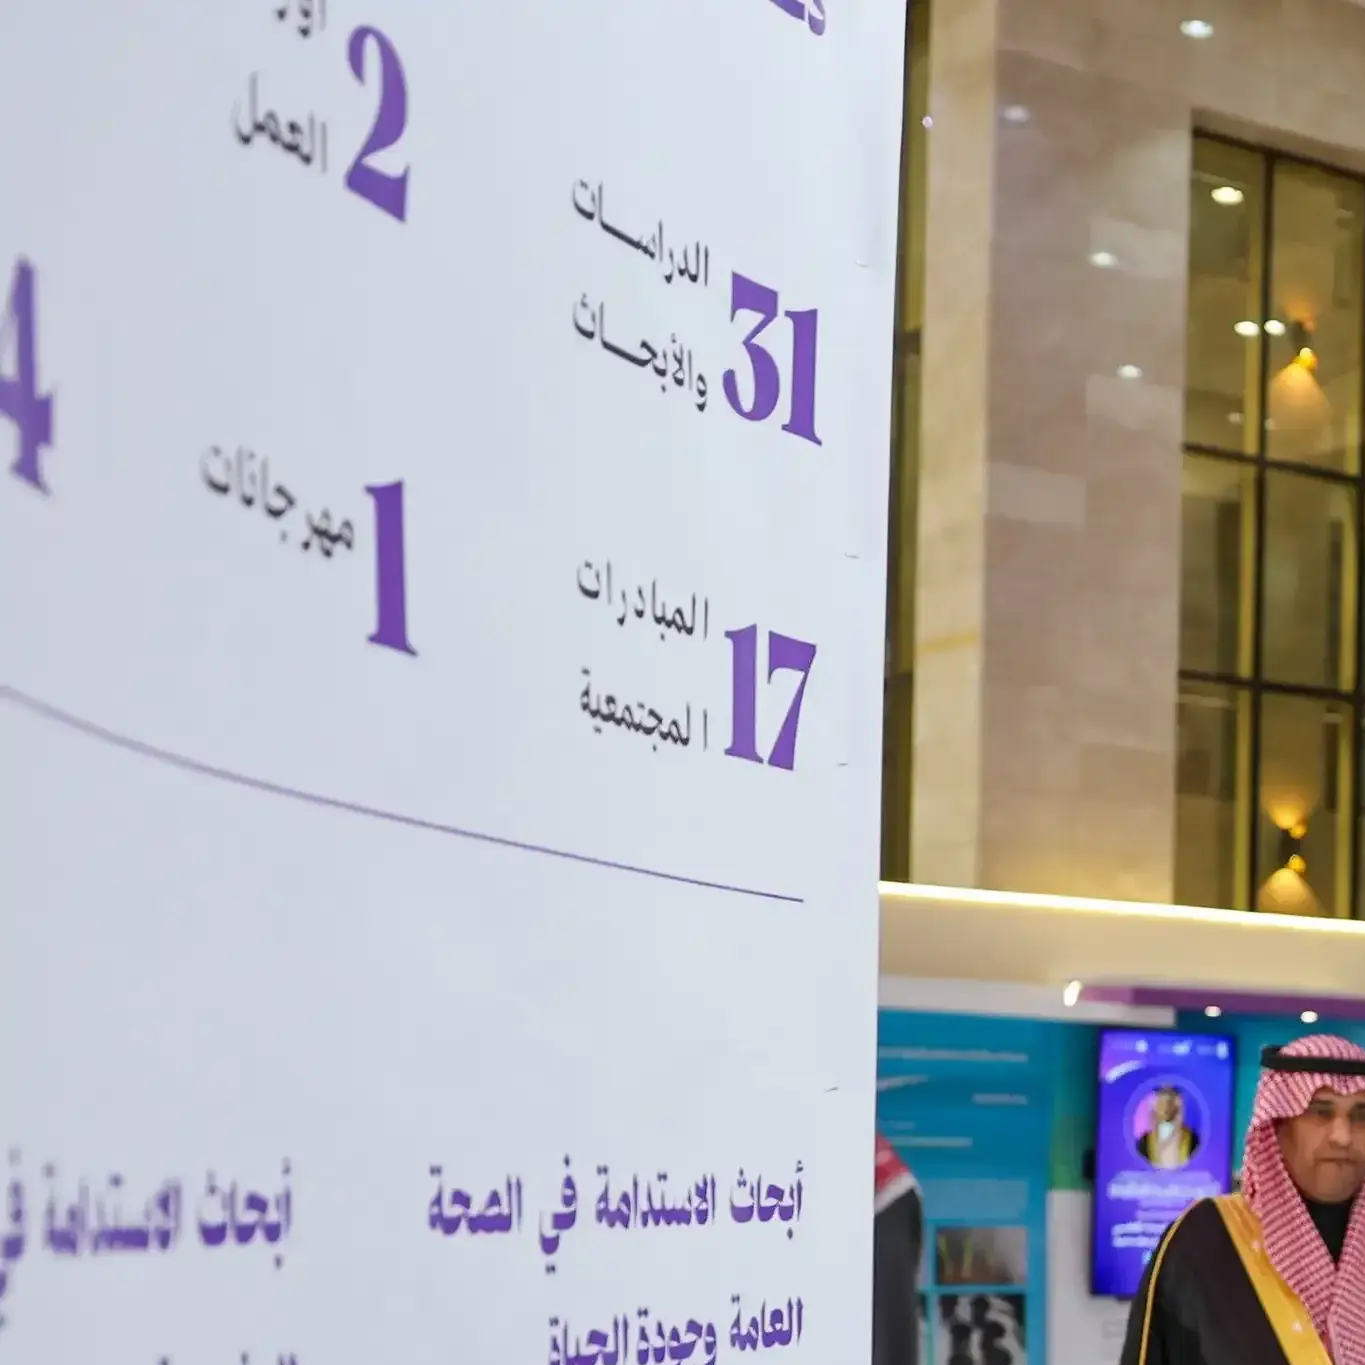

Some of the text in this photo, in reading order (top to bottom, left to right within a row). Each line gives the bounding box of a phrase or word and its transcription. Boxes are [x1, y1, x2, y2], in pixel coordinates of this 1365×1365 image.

[230, 70, 328, 175] العمل
[344, 24, 410, 224] 2
[572, 179, 709, 288] الدراسات
[572, 292, 708, 413] والأبحاث
[722, 269, 823, 447] 31
[200, 444, 355, 559] مهرجانات
[363, 478, 419, 658] 1
[577, 559, 709, 642] المبادرات
[580, 666, 709, 752] المجتمعية
[723, 622, 817, 772] 17
[427, 1153, 804, 1275] أبحاث الاستدامة في الصحة
[729, 1293, 804, 1352] العامة
